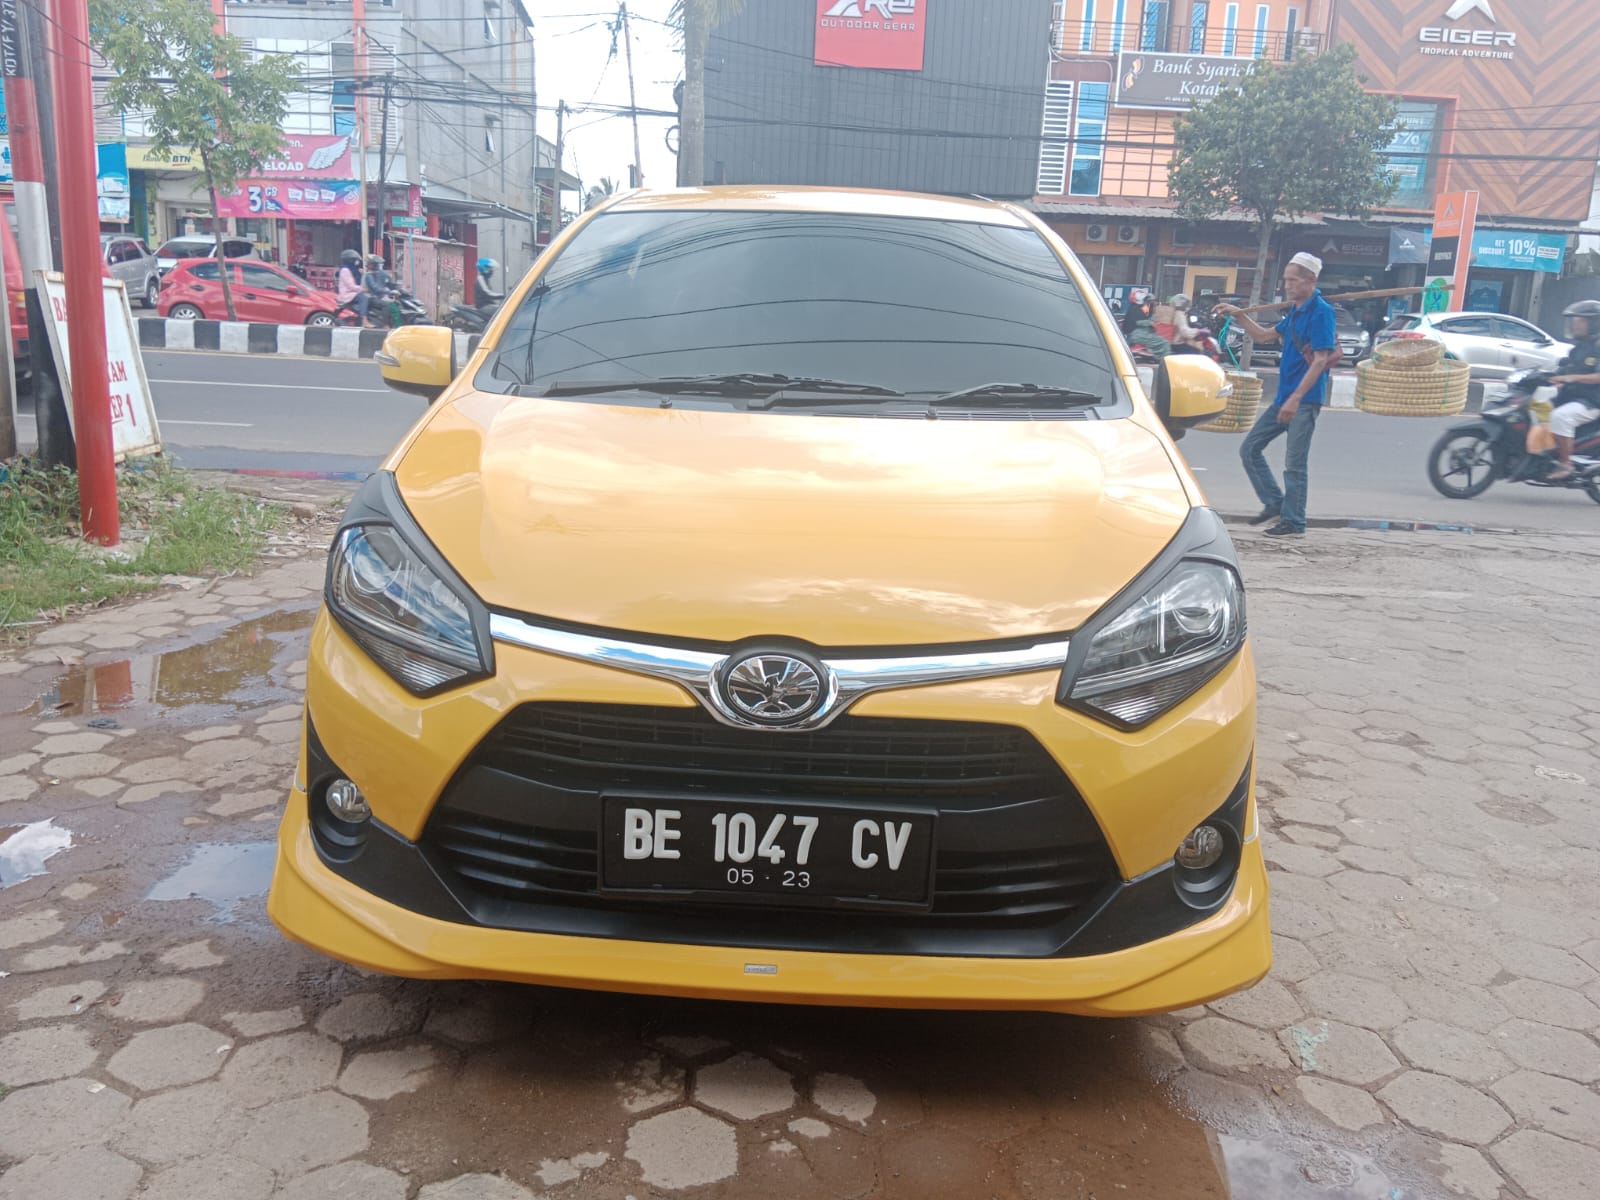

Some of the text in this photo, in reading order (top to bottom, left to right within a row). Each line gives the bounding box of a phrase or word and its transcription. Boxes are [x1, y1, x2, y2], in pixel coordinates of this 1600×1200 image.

[820, 18, 915, 30] OUTDOOR GEAR
[1419, 26, 1517, 47] EIGER
[1420, 46, 1514, 60] TROPICAL ADVENTURE
[1152, 58, 1192, 75] Bank
[172, 154, 191, 163] BTN
[247, 185, 262, 213] 3
[1508, 239, 1536, 256] 10%
[126, 393, 137, 427] 1
[623, 807, 913, 871] BE 1047 CV
[726, 868, 811, 888] 05 23
